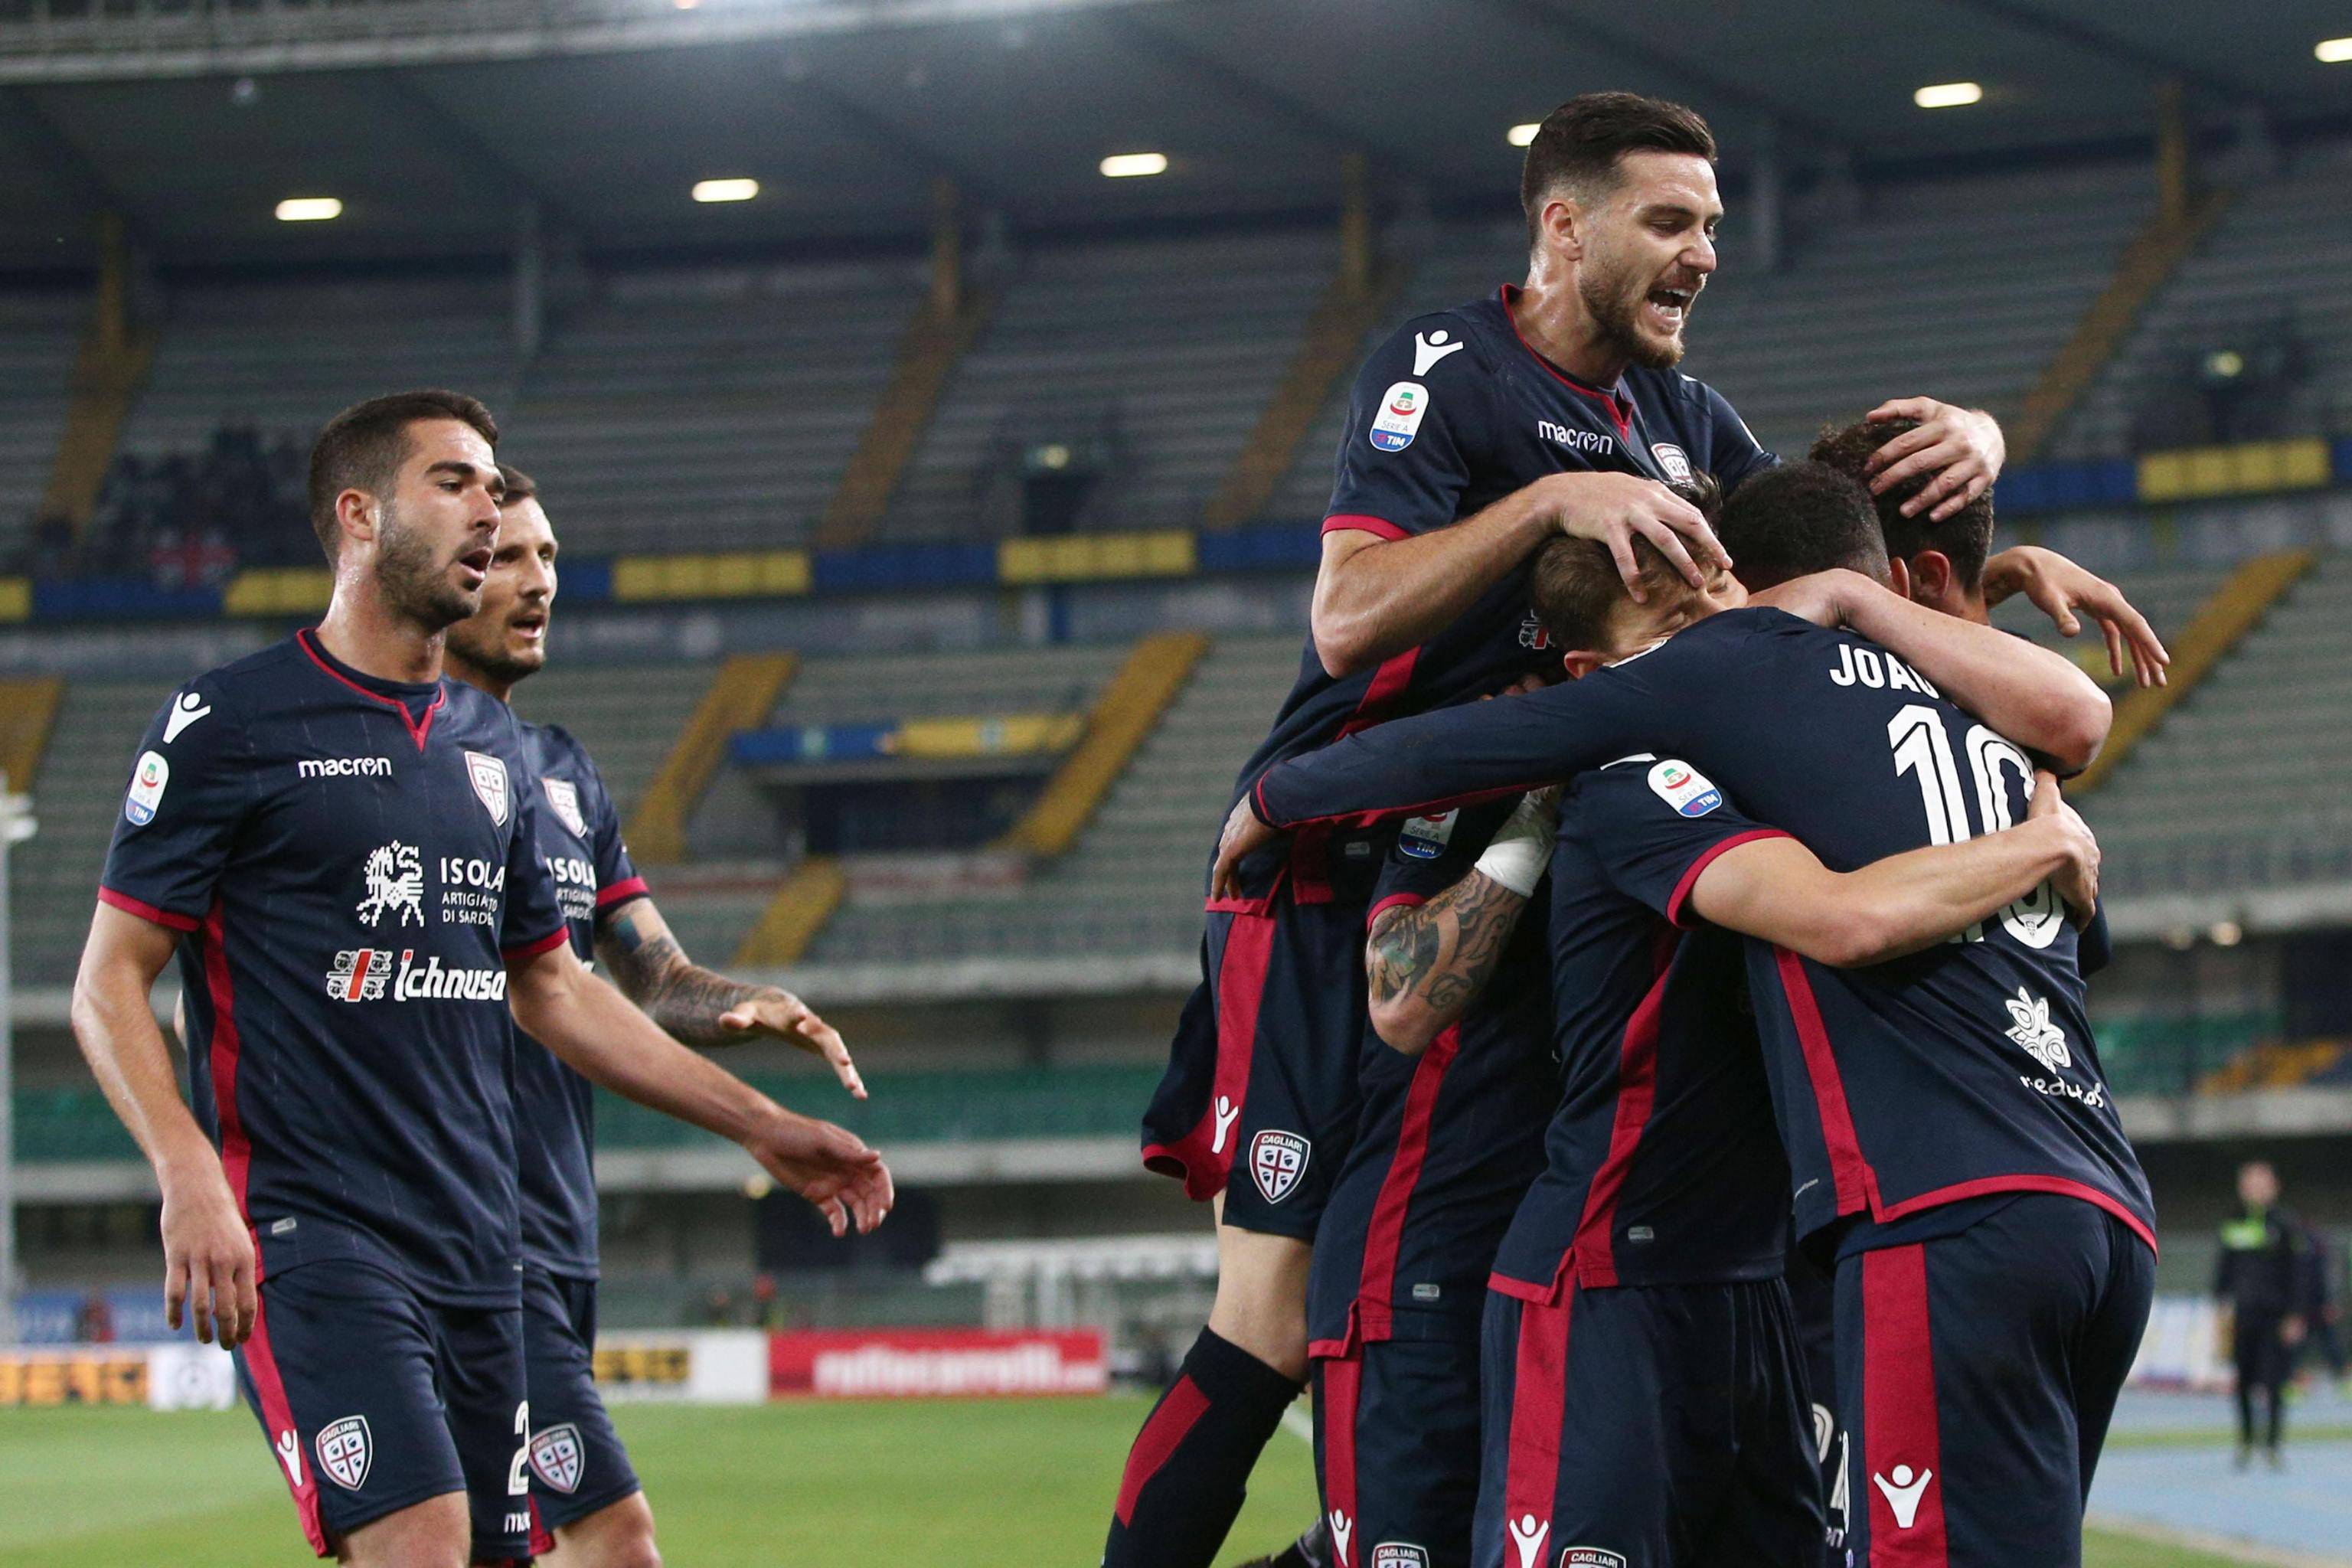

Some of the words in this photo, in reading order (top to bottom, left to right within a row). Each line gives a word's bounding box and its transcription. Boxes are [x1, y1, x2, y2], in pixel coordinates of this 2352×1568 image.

[1387, 435, 1406, 446] TIM
[1538, 420, 1613, 455] macron
[298, 757, 392, 778] macron
[1697, 793, 1719, 806] TIM
[440, 857, 505, 892] ISOLA
[443, 909, 455, 923] DI
[1261, 1135, 1303, 1152] CAGLIARI
[1378, 1548, 1419, 1560] CAGLIARI
[1570, 1553, 1619, 1568] CAGLIARI
